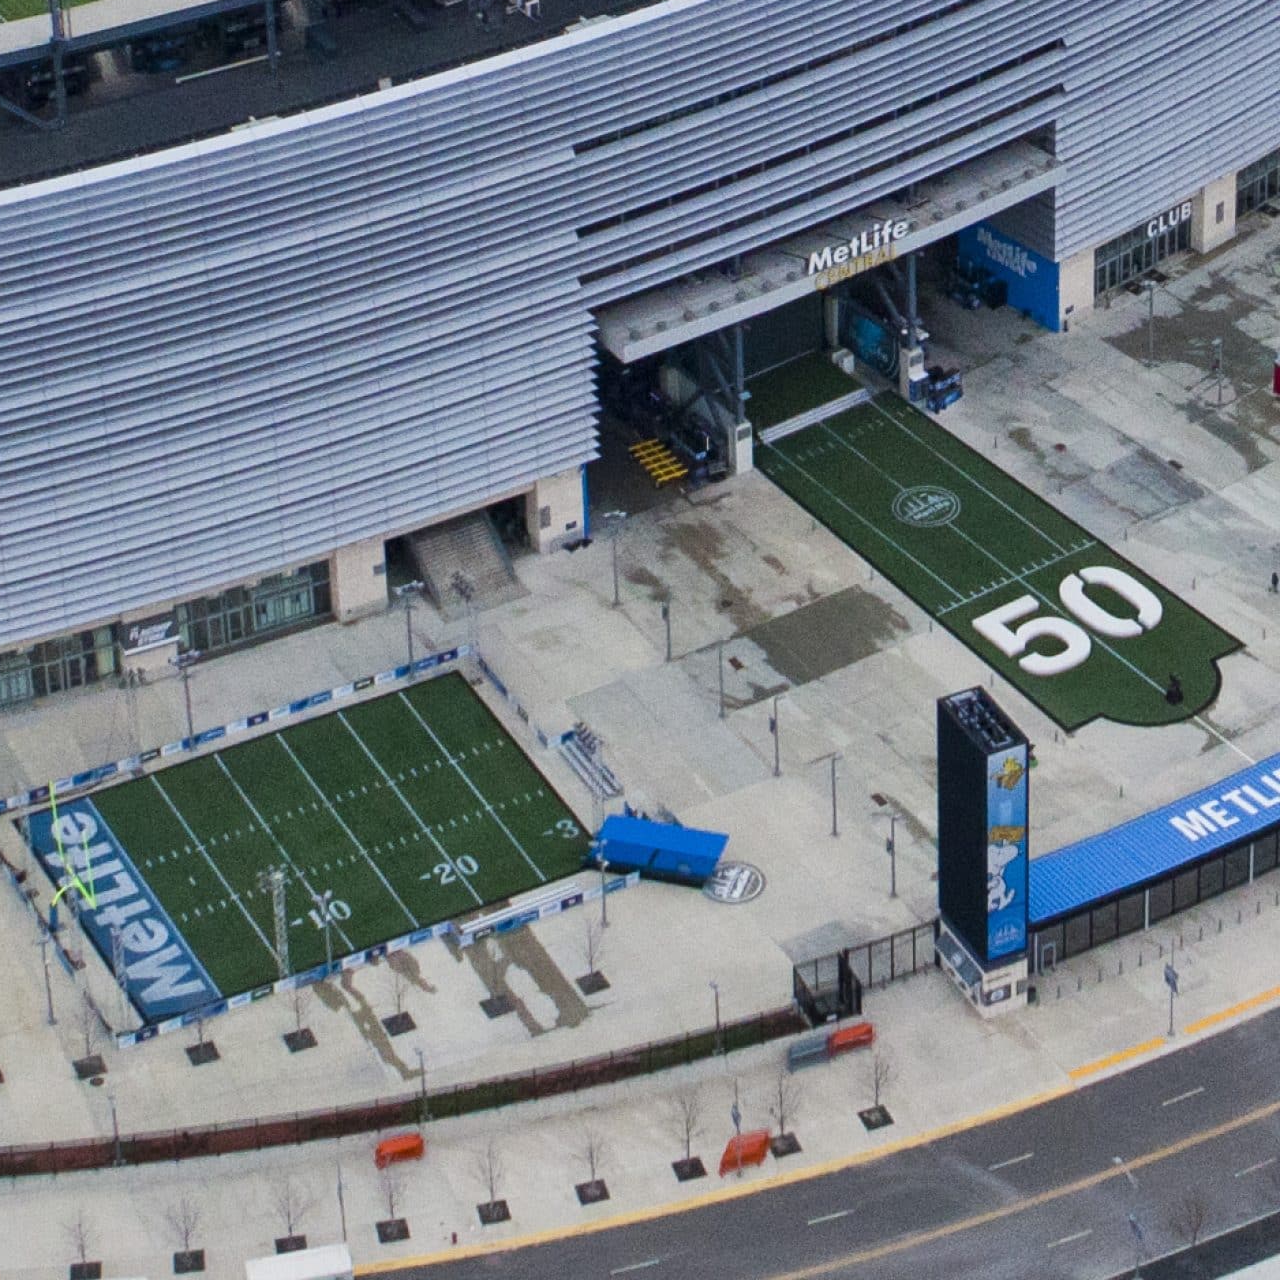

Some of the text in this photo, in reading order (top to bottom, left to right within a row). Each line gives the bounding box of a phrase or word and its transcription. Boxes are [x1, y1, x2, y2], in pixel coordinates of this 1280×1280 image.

[808, 219, 909, 276] MetLife
[1147, 202, 1192, 238] CLUB
[972, 566, 1164, 676] 50
[432, 855, 480, 886] 20
[45, 811, 207, 1004] MetLife
